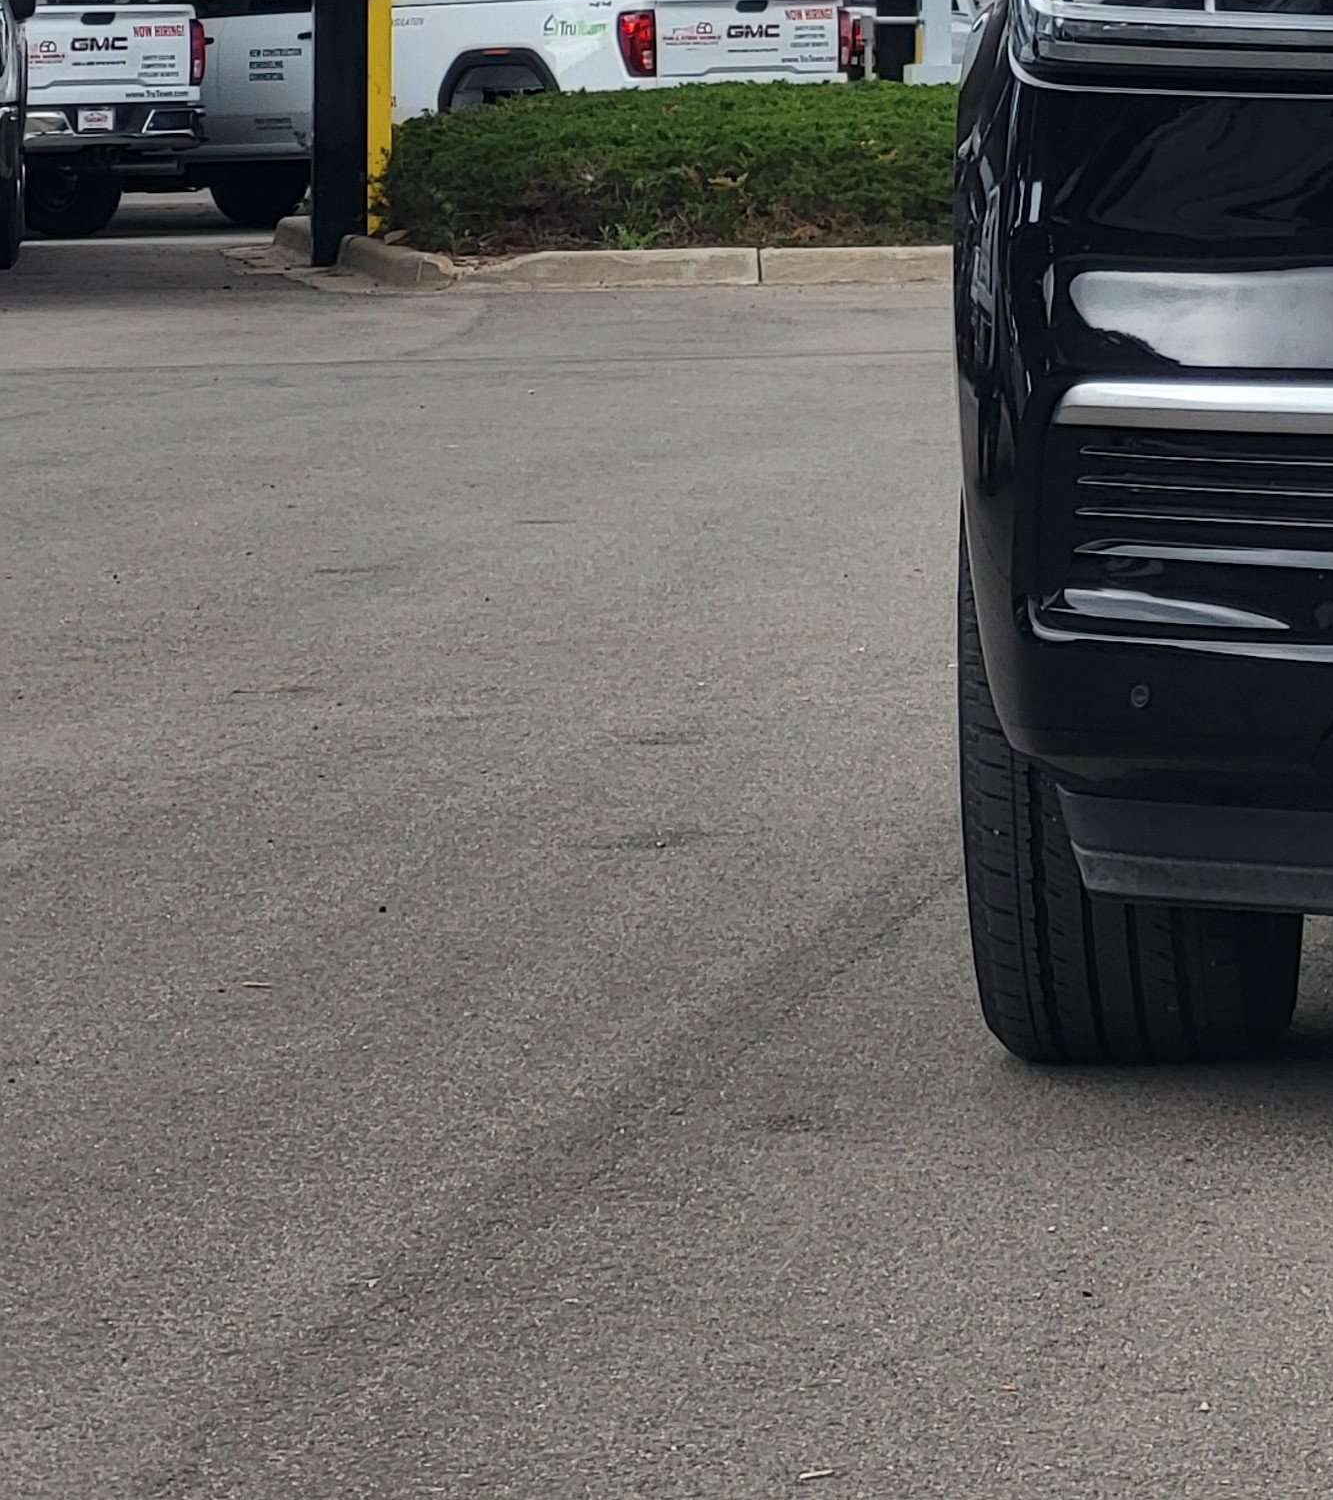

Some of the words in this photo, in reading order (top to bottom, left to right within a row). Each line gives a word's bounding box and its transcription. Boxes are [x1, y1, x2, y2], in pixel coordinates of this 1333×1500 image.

[133, 26, 152, 38] NOW
[726, 24, 781, 39] GMC
[71, 36, 129, 52] GMC
